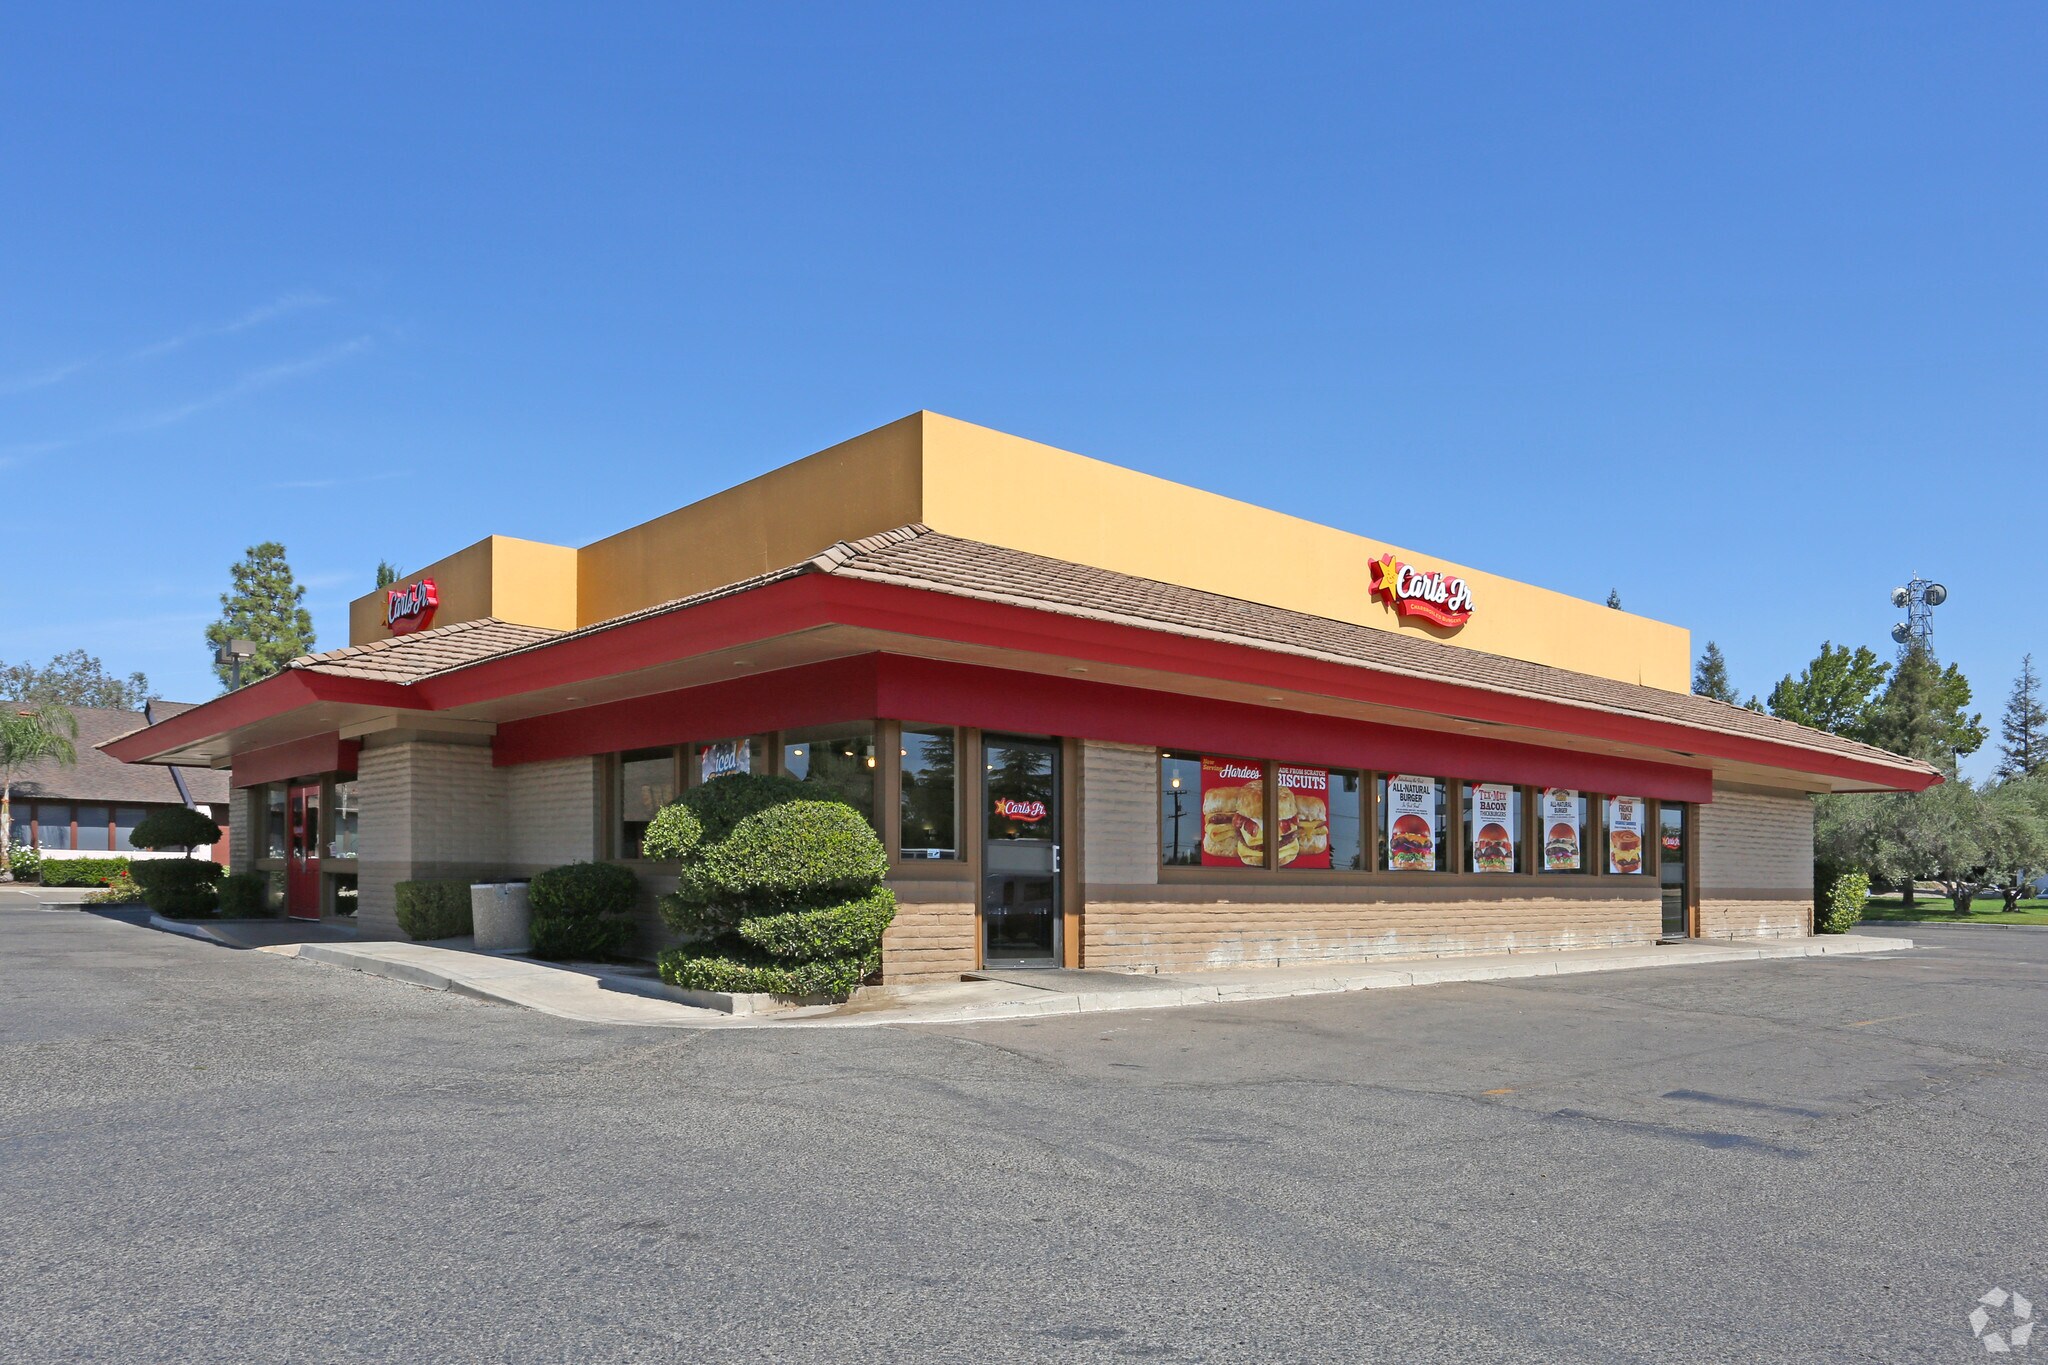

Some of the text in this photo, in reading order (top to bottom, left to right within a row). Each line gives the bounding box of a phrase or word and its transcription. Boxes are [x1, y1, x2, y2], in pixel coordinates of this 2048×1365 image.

[1397, 565, 1475, 611] Carl's Jr.
[389, 580, 429, 623] Carl's Jr.
[716, 744, 736, 772] iced
[1220, 764, 1262, 779] Hardee's
[1304, 769, 1326, 777] SCRATCH
[1393, 783, 1430, 794] ALL-NATURAL
[1400, 793, 1422, 802] BURGER
[1005, 801, 1046, 815] Carl's Jr.
[1480, 802, 1506, 810] BACON
